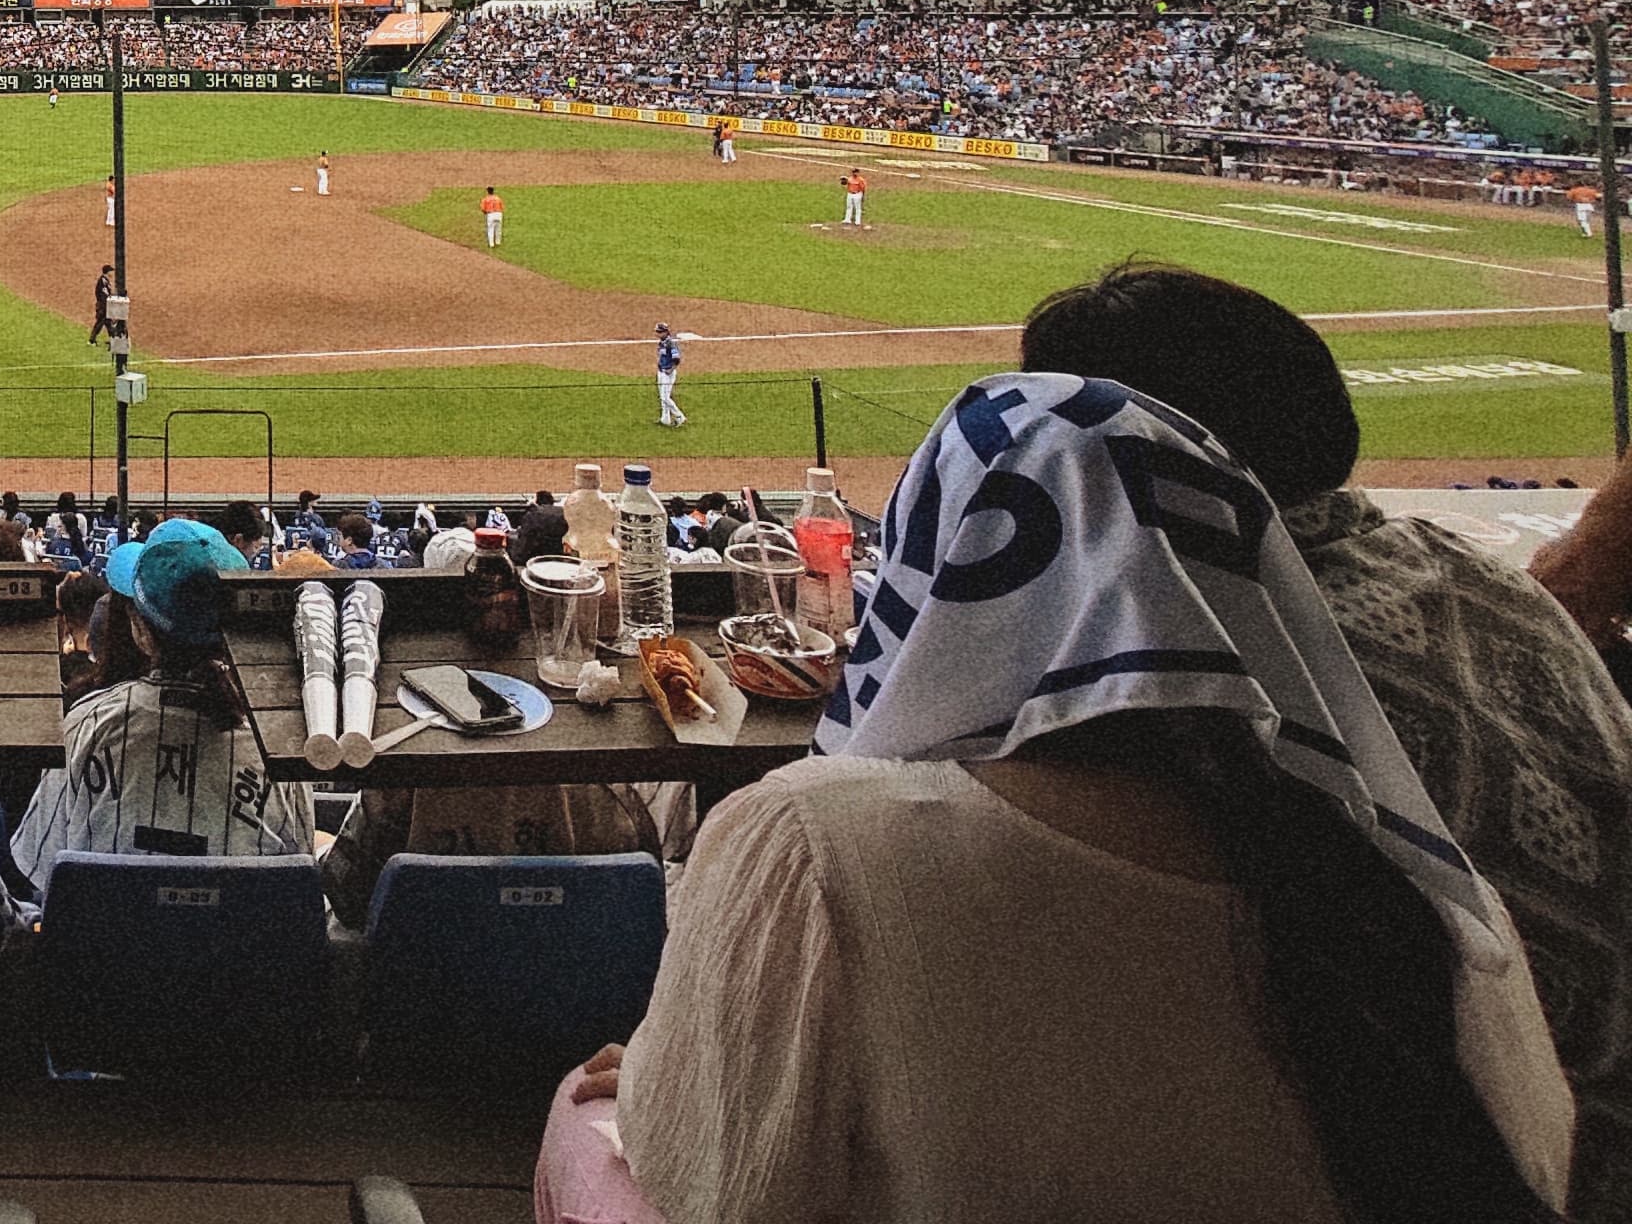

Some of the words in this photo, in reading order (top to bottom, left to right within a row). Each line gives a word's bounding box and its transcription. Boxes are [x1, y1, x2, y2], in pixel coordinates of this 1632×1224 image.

[33, 74, 55, 89] 3H
[58, 74, 104, 89] 지압침대
[122, 73, 141, 89] 3H
[143, 73, 191, 88] 지압침대
[205, 74, 228, 88] 3H
[231, 73, 278, 88] 지압침대
[611, 107, 639, 119] BESKO
[657, 112, 687, 123] BESKO
[762, 121, 798, 136] BESKO
[823, 127, 862, 141] BESKO
[890, 133, 933, 147] BESKO
[965, 140, 1013, 155] BESKO
[1341, 355, 1585, 386] 화손해보험
